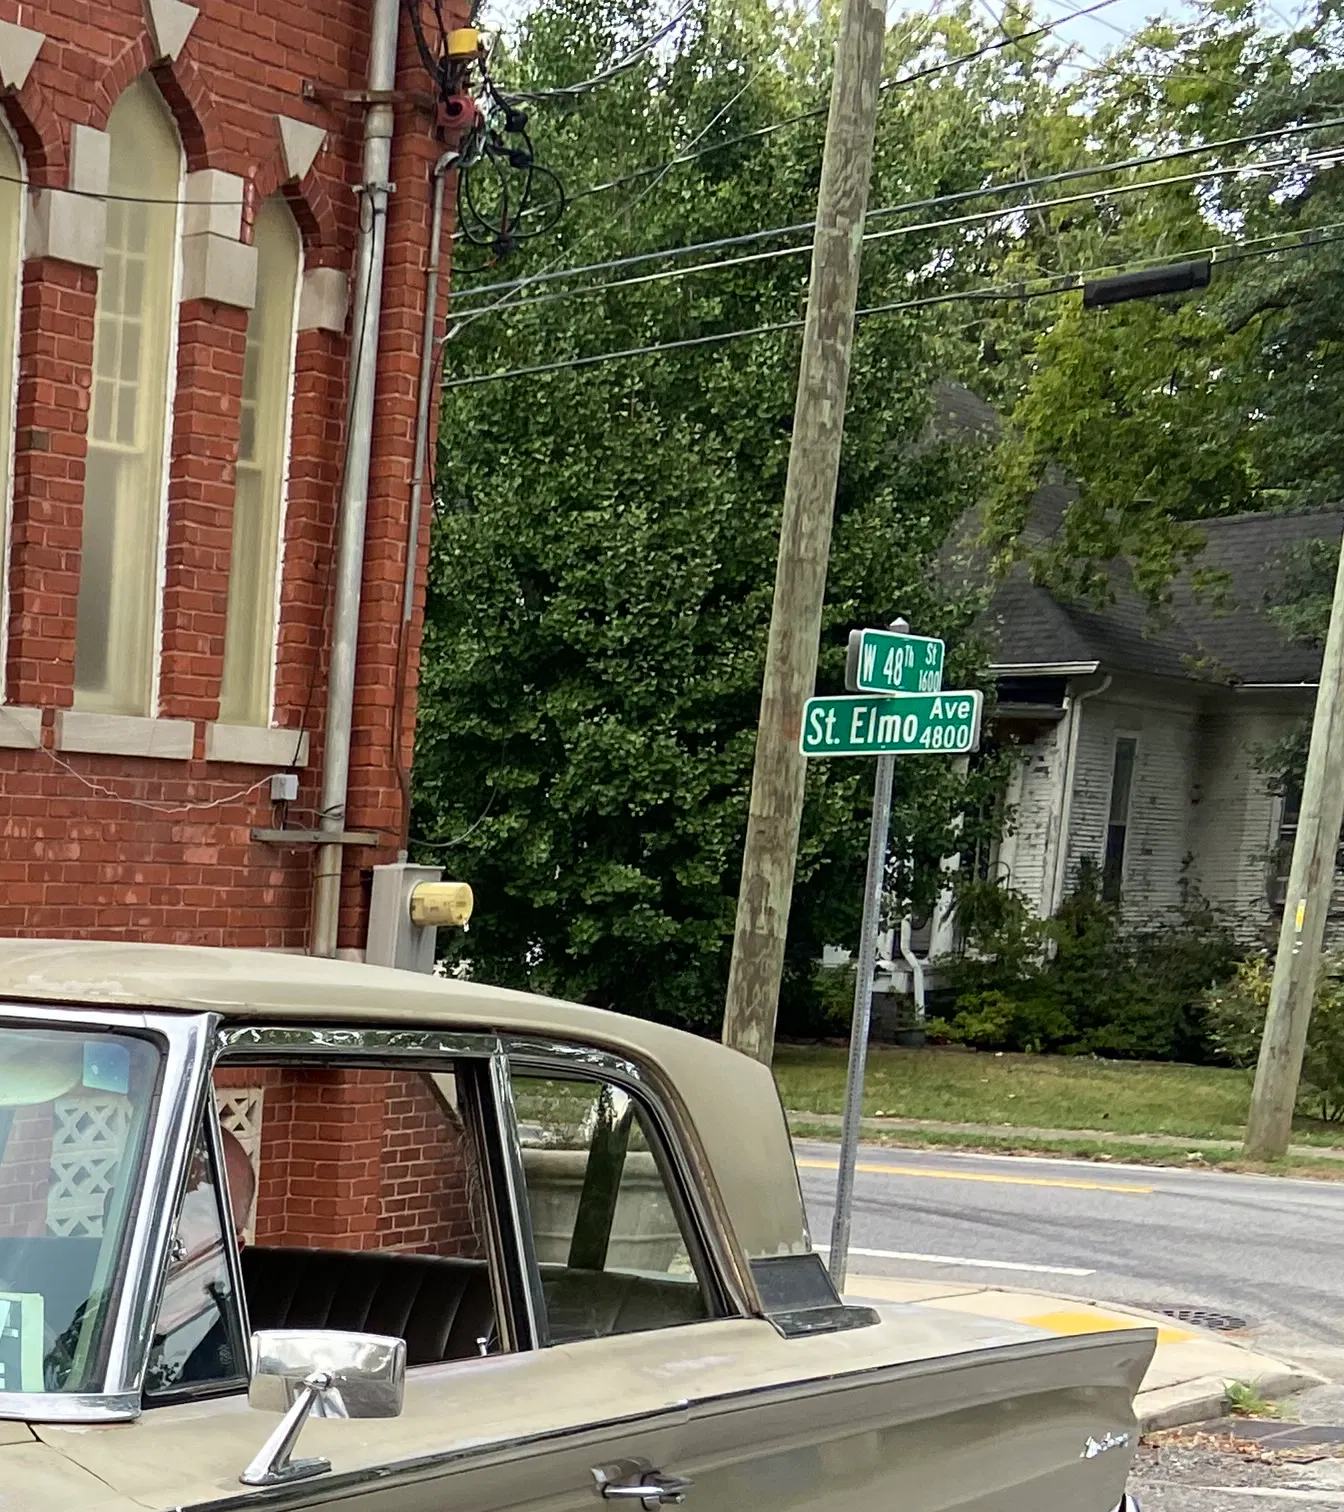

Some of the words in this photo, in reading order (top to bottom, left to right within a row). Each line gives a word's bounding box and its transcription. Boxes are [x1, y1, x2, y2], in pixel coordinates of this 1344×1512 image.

[863, 643, 877, 682] W
[925, 643, 937, 665] St
[919, 669, 941, 692] 1600
[806, 707, 840, 745] St.
[849, 706, 918, 744] Elmo
[929, 697, 970, 720] Ave
[919, 725, 969, 749] 4800
